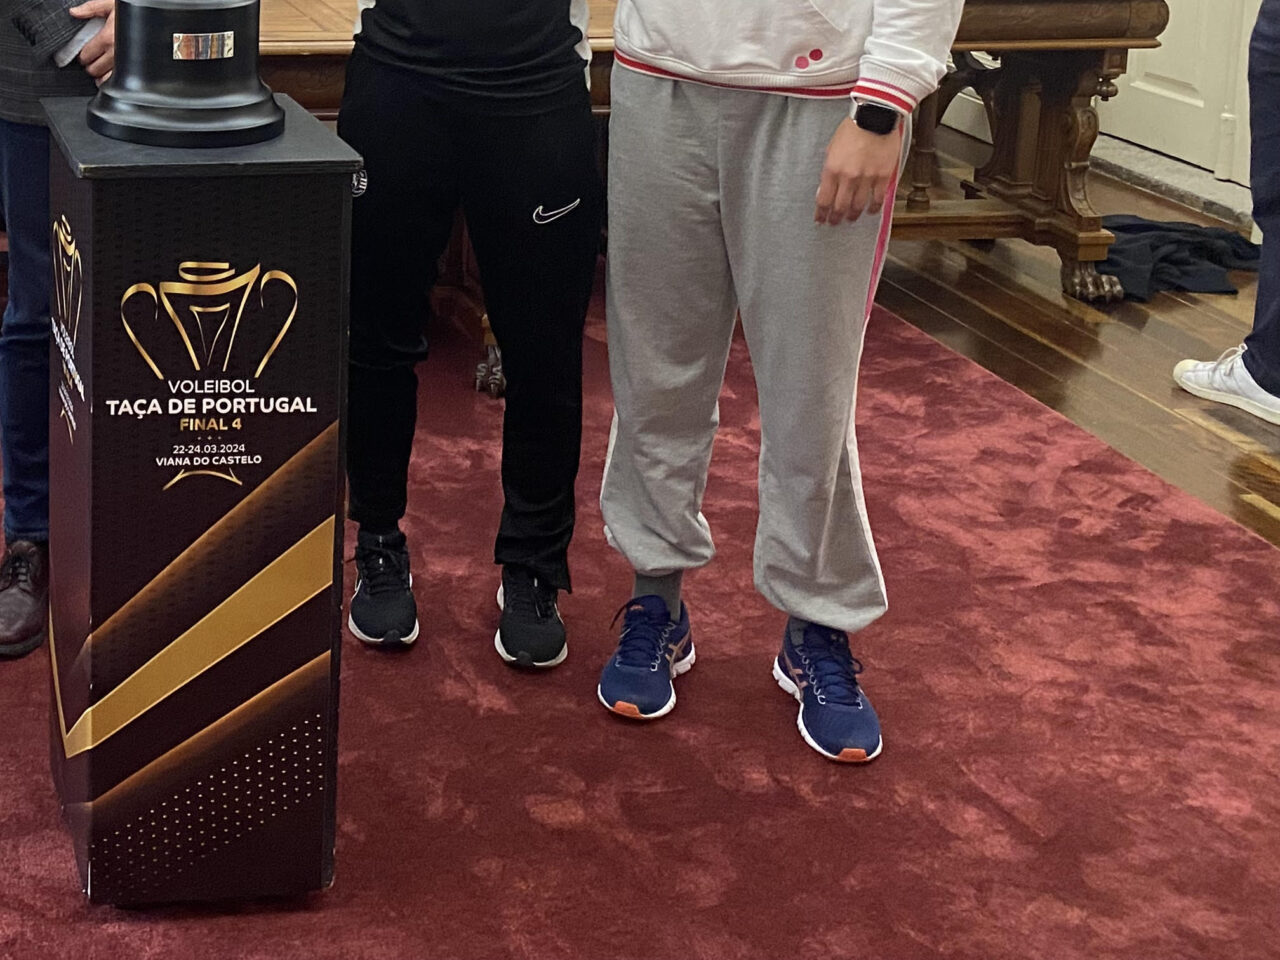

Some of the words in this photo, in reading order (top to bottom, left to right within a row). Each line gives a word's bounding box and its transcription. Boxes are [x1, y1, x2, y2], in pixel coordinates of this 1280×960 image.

[168, 379, 255, 393] VOLEIBOL
[106, 399, 163, 419] TAÇA
[168, 398, 197, 414] DE
[202, 397, 317, 414] PORTUGAL
[180, 418, 228, 431] FINAL
[231, 418, 242, 430] 4
[172, 444, 245, 454] 22-24.03.2024
[156, 456, 191, 466] VIANA
[193, 456, 210, 465] DO
[212, 455, 262, 464] CASTELO
